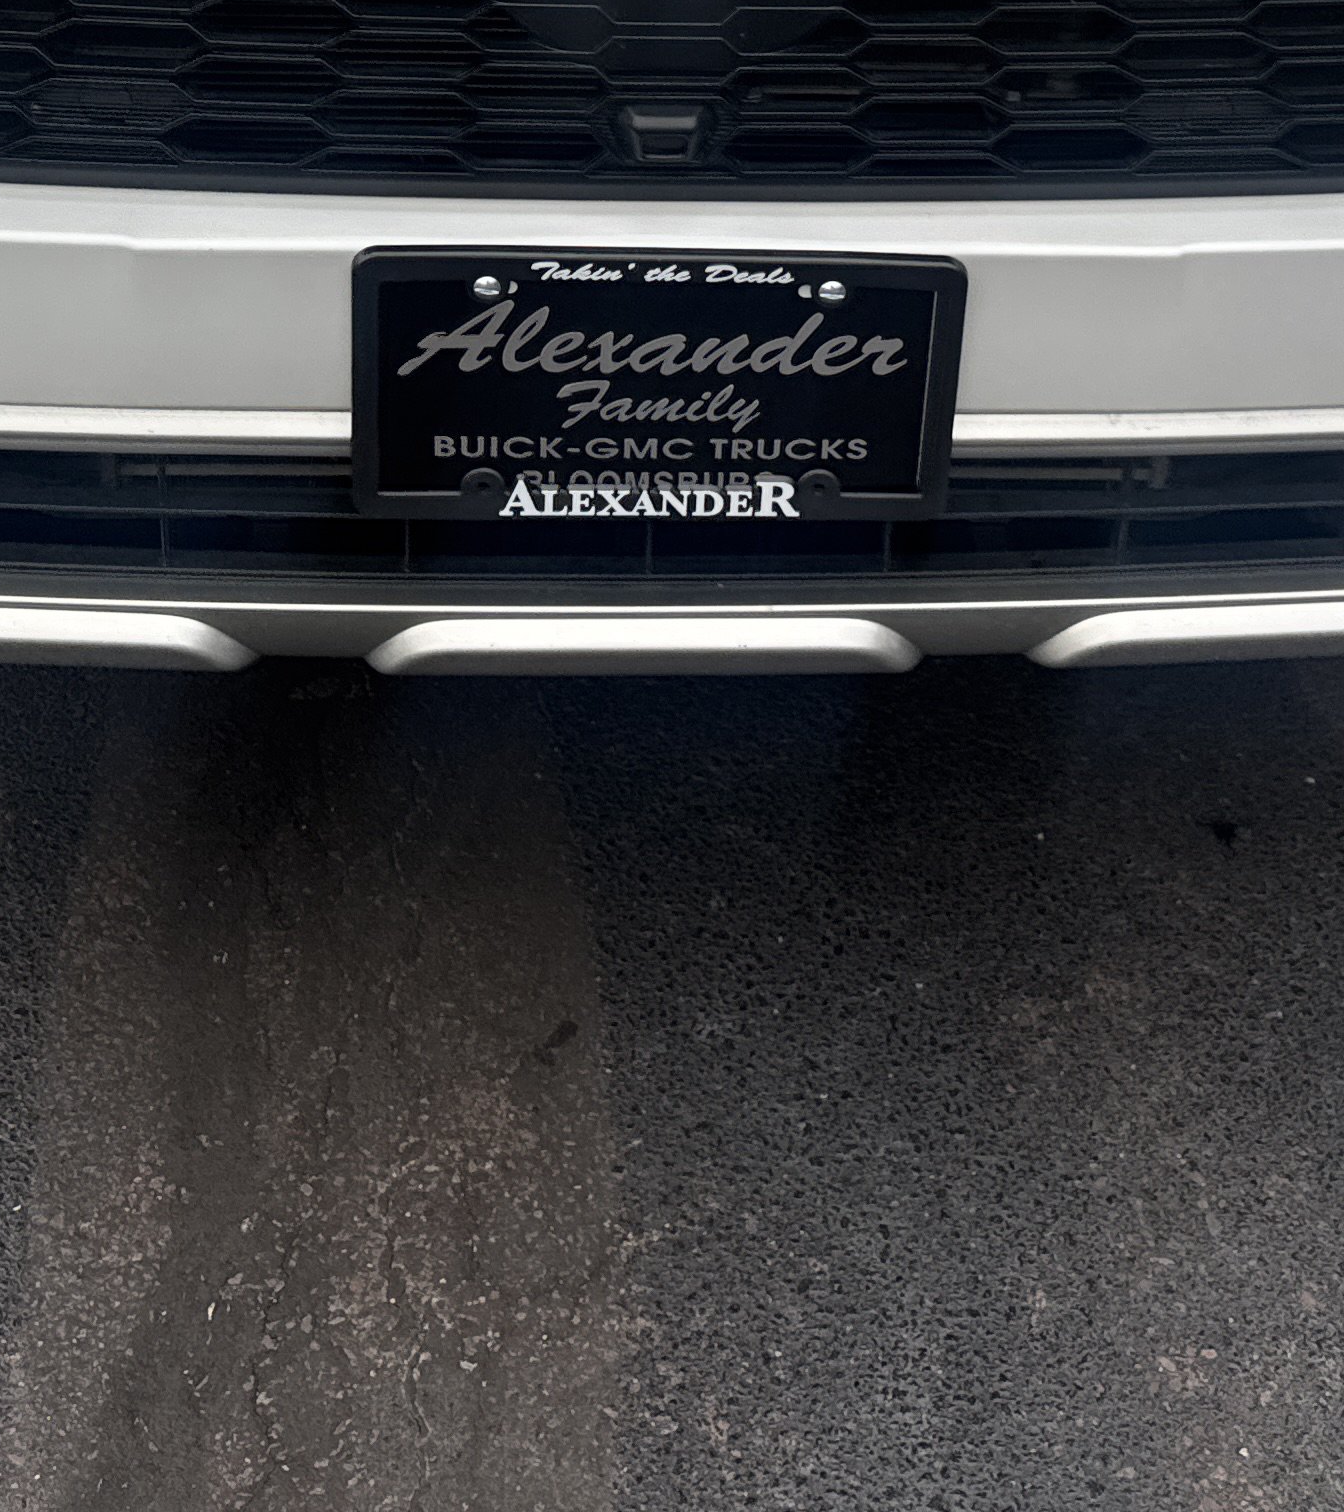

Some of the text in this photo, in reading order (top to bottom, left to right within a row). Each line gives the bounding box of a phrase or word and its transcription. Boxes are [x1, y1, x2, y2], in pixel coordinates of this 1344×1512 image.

[531, 261, 795, 285] Takin' the Deals
[397, 298, 908, 377] Alexander
[556, 379, 761, 432] Family
[433, 434, 869, 462] BUICK-GMC TRUCKS
[498, 478, 801, 518] ALEXANDER
